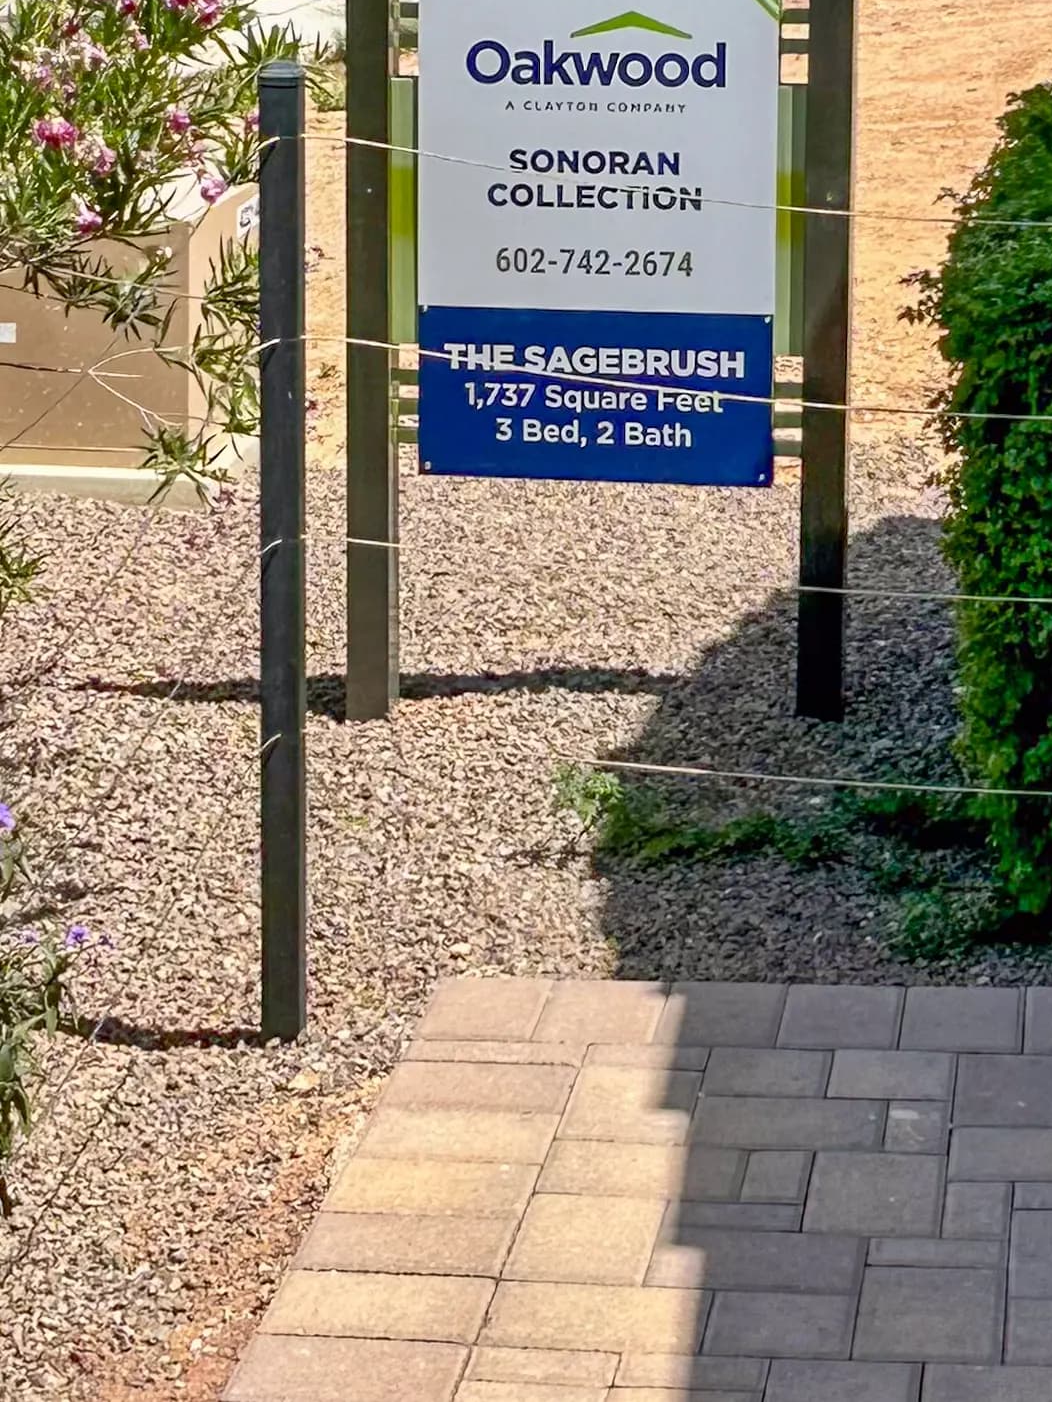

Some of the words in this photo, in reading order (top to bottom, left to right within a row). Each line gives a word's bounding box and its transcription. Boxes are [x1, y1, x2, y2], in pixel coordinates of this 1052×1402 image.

[466, 40, 727, 89] Oakwood
[505, 100, 515, 111] A
[523, 100, 599, 113] CLAYTON
[607, 101, 687, 114] COMPANY
[509, 149, 681, 175] SONORAN
[487, 183, 703, 211] COLLECTION
[495, 248, 694, 277] 602-742-2674
[444, 343, 515, 370] THE
[523, 346, 746, 378] SAGEBRUSH
[464, 383, 536, 409] 1,737
[545, 384, 648, 413] Square
[657, 388, 724, 413] Feet
[495, 418, 512, 441] 3
[523, 418, 587, 448] Bed,
[596, 421, 614, 444] 2
[624, 422, 692, 447] Bath
